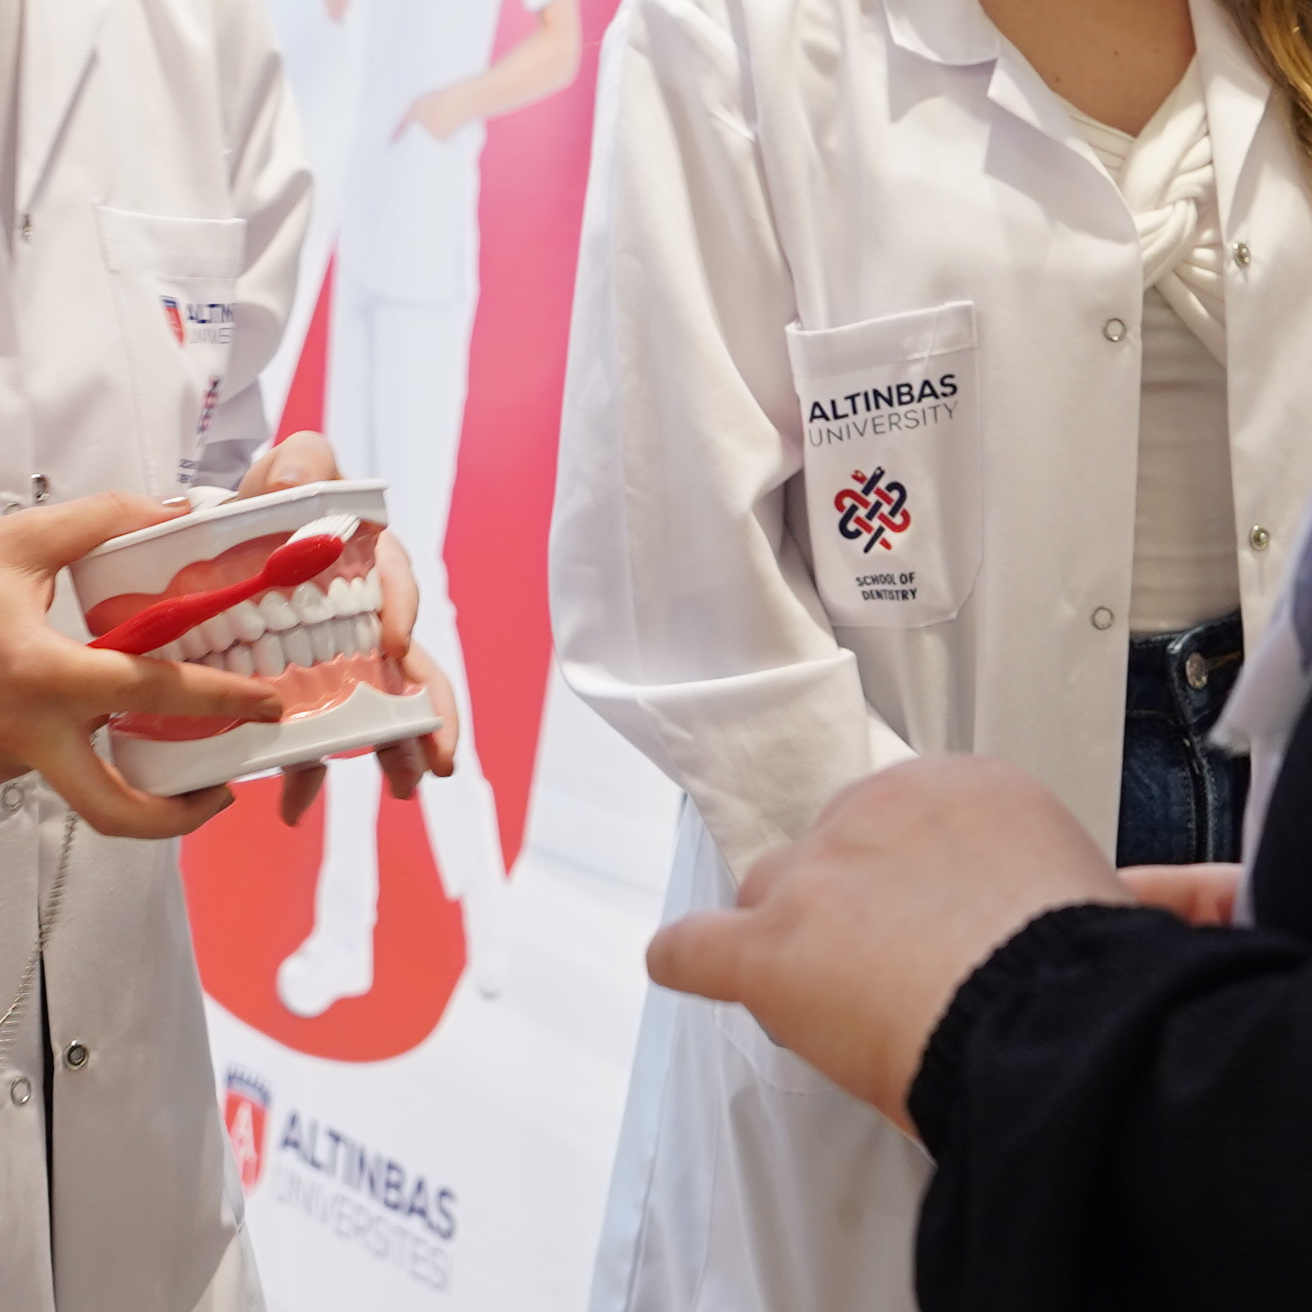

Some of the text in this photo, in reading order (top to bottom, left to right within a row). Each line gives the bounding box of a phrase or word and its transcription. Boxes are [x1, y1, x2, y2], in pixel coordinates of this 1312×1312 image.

[808, 373, 958, 424] ALTINBAS
[807, 400, 959, 447] UNIVERSITY
[855, 571, 916, 588] SCHOOL OF
[861, 588, 918, 601] DENTISTRY
[280, 1111, 457, 1240] ALTINBAS
